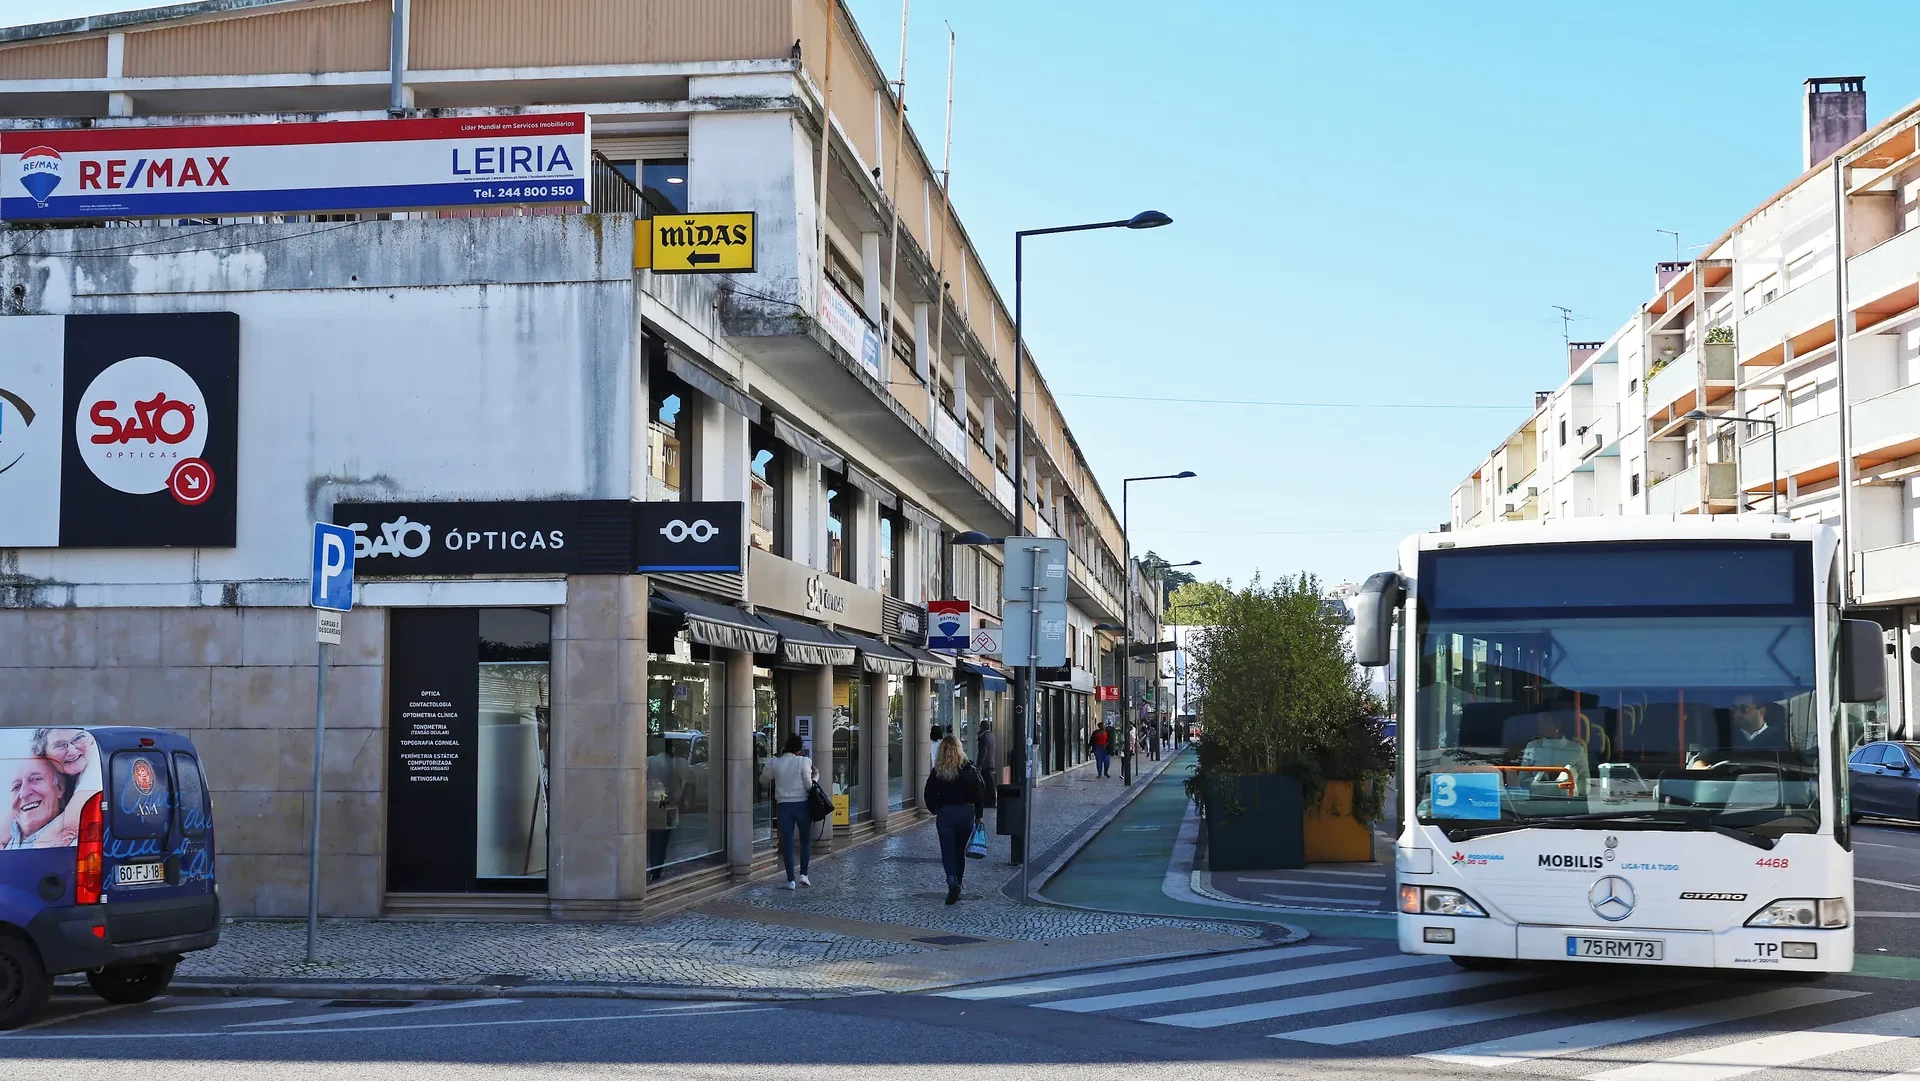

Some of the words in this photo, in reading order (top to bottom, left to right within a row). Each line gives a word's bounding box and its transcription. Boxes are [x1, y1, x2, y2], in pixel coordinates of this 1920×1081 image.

[460, 124, 476, 132] Líder
[513, 122, 539, 130] Serviços
[540, 120, 575, 128] Imobiliários
[23, 160, 59, 172] RE/MAX
[452, 144, 574, 175] LEIRIA
[79, 157, 230, 190] RE/MAX
[474, 188, 495, 199] Tel.
[498, 187, 521, 198] 244
[524, 186, 548, 197] 800
[551, 185, 574, 196] 550
[445, 527, 565, 551] ÓPTICAS
[320, 532, 346, 599] P
[320, 619, 336, 628] CARGAS
[318, 626, 341, 636] DESCARGAS
[1435, 775, 1456, 806] 3
[1538, 854, 1603, 868] MOBILIS
[1756, 858, 1789, 868] 4468
[1755, 943, 1778, 956] TP
